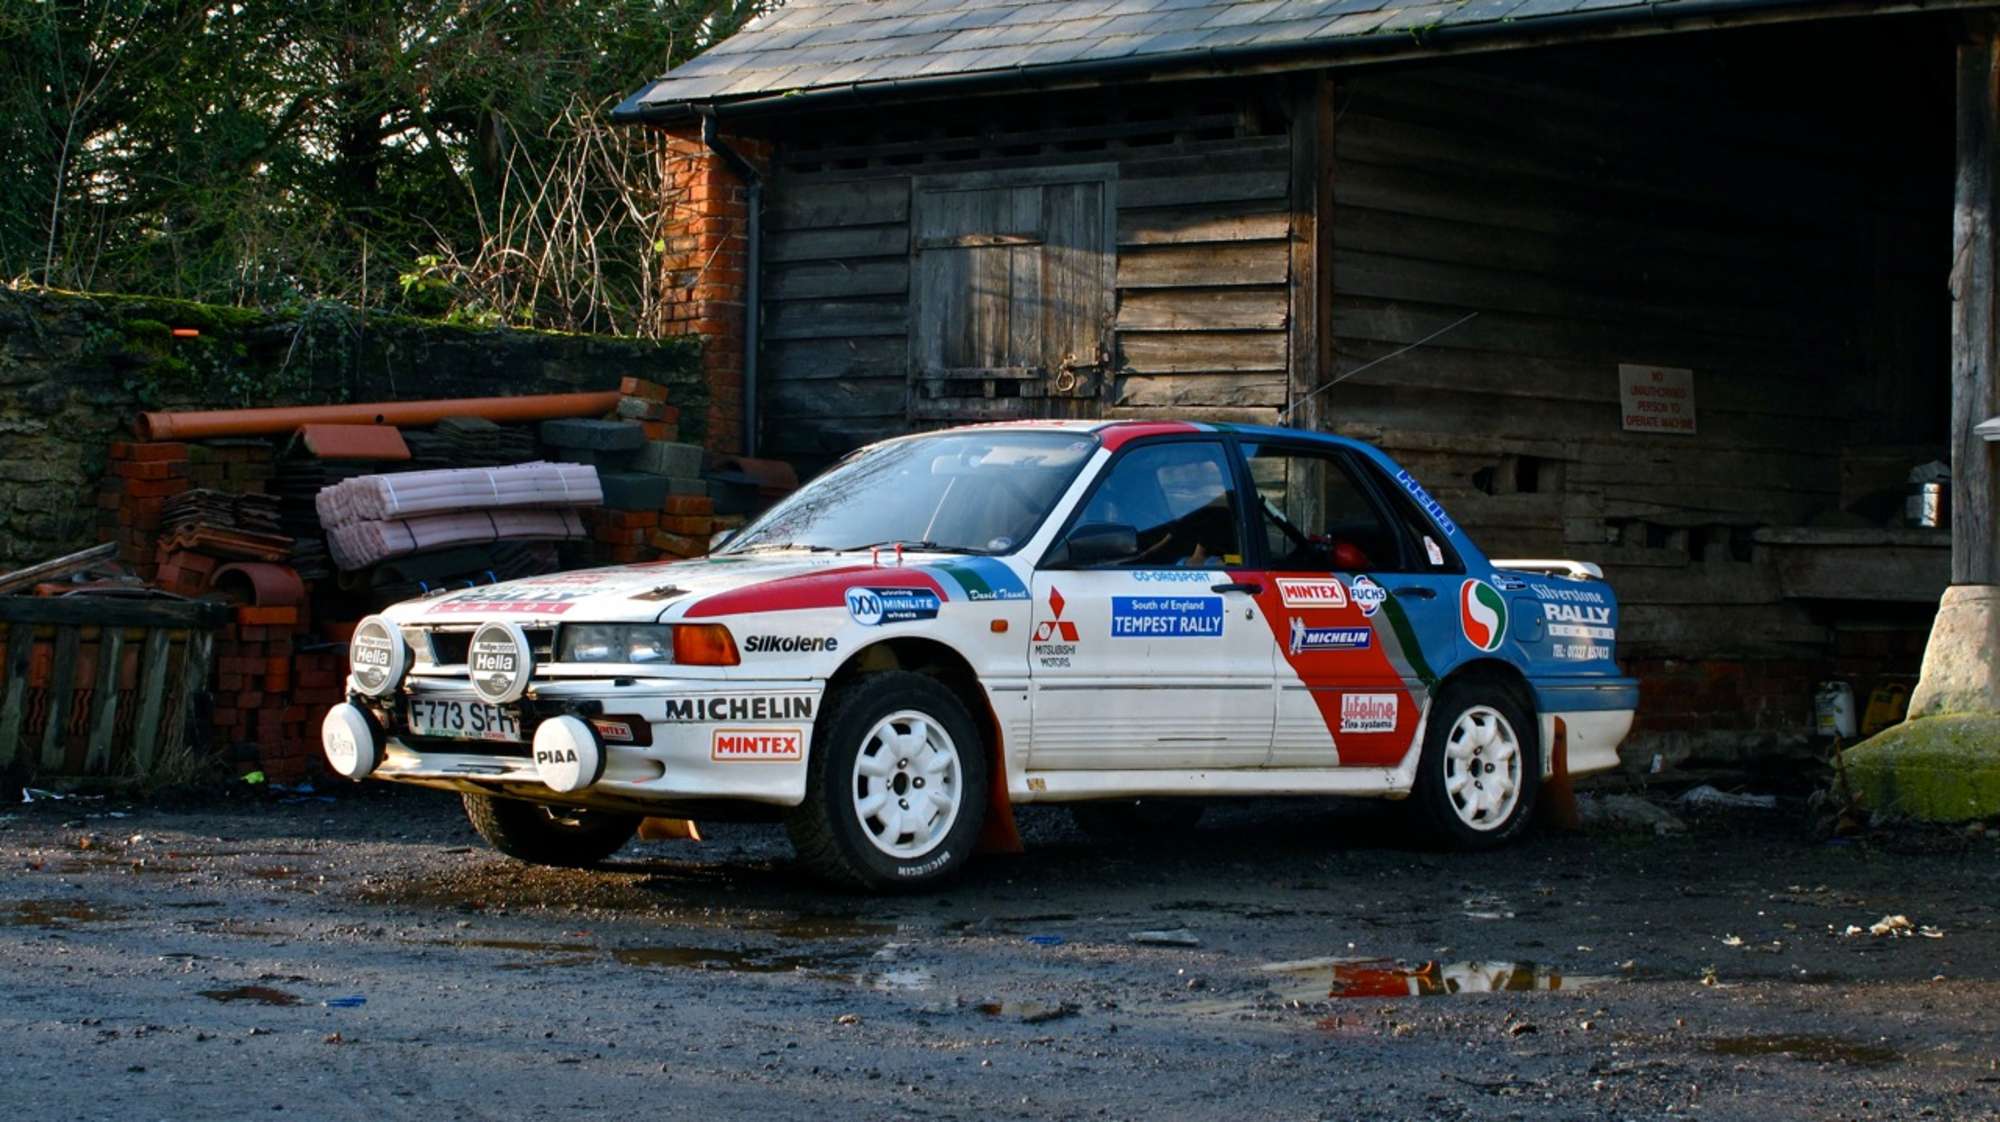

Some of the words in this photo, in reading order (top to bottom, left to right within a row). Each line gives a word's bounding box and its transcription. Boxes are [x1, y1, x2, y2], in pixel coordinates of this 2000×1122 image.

[1649, 371, 1664, 381] NO
[1626, 415, 1658, 427] OPERATE
[1396, 469, 1456, 536] Hella
[1284, 585, 1339, 599] MINTEX
[1351, 588, 1385, 600] FUCHS
[1531, 583, 1604, 603] Silverstone
[883, 599, 934, 609] MINILITE
[1132, 600, 1158, 610] South
[1160, 600, 1169, 610] of
[1171, 600, 1205, 613] England
[1542, 603, 1611, 624] RALLY
[1114, 617, 1177, 633] TEMPEST
[1179, 617, 1222, 633] RALLY
[744, 635, 838, 652] Silkolene
[1306, 632, 1368, 643] MICHELIN
[356, 647, 388, 665] Hella
[1035, 645, 1076, 655] MITSUBISHI
[476, 654, 513, 670] Hella
[1040, 658, 1071, 668] MOTORS
[411, 700, 465, 730] F773
[665, 696, 812, 720] MICHELIN
[1343, 696, 1396, 719] lifeline
[1344, 720, 1358, 729] fire
[1360, 720, 1393, 730] systems
[717, 736, 797, 754] MINTEX
[536, 748, 578, 765] PIAA
